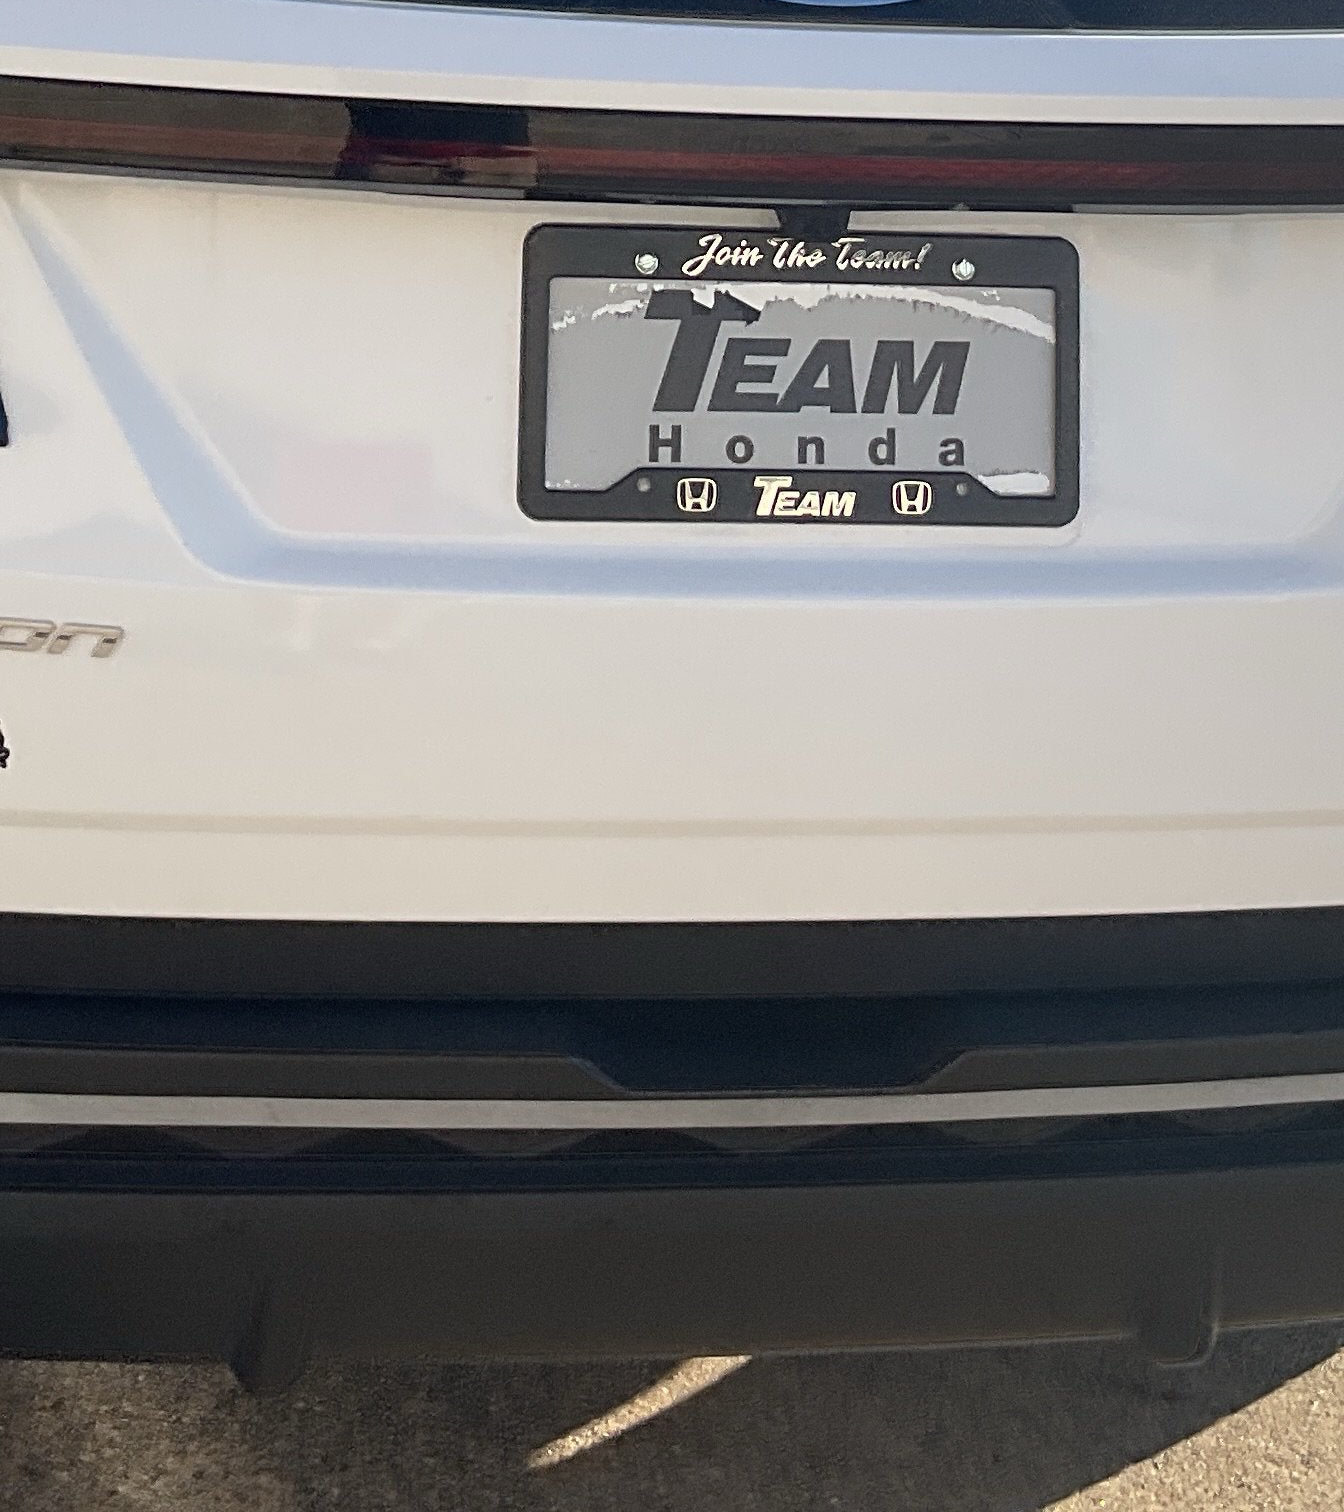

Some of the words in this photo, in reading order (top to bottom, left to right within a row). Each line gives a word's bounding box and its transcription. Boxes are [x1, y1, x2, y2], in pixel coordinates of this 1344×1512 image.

[681, 233, 764, 276] Join
[767, 237, 827, 269] The
[831, 237, 933, 271] Team!
[643, 289, 970, 415] TEAM
[647, 424, 966, 467] Honda
[753, 475, 856, 517] TEAM
